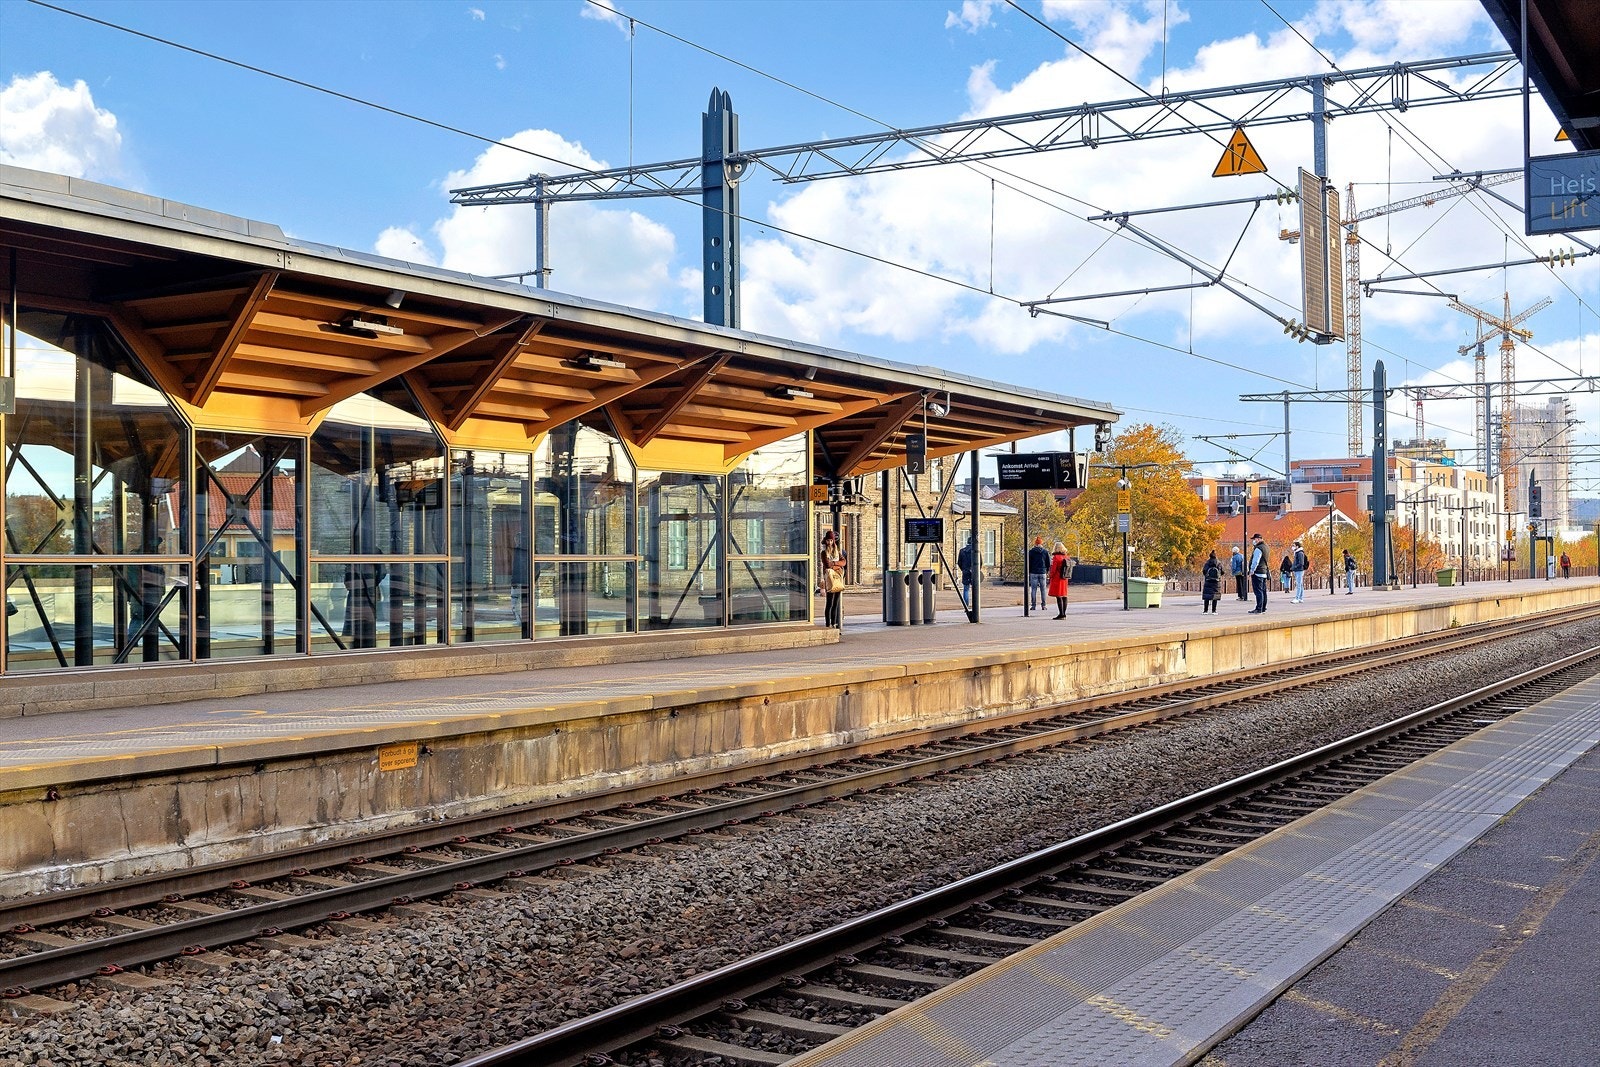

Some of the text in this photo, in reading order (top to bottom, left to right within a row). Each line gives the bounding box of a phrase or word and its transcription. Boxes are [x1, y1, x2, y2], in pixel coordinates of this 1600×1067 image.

[1229, 143, 1247, 171] 17
[1551, 174, 1596, 195] Heis
[1551, 198, 1588, 220] Lift
[912, 461, 919, 471] 2
[1063, 470, 1071, 482] 2
[381, 749, 401, 758] Forbudt
[394, 758, 415, 766] sporene
